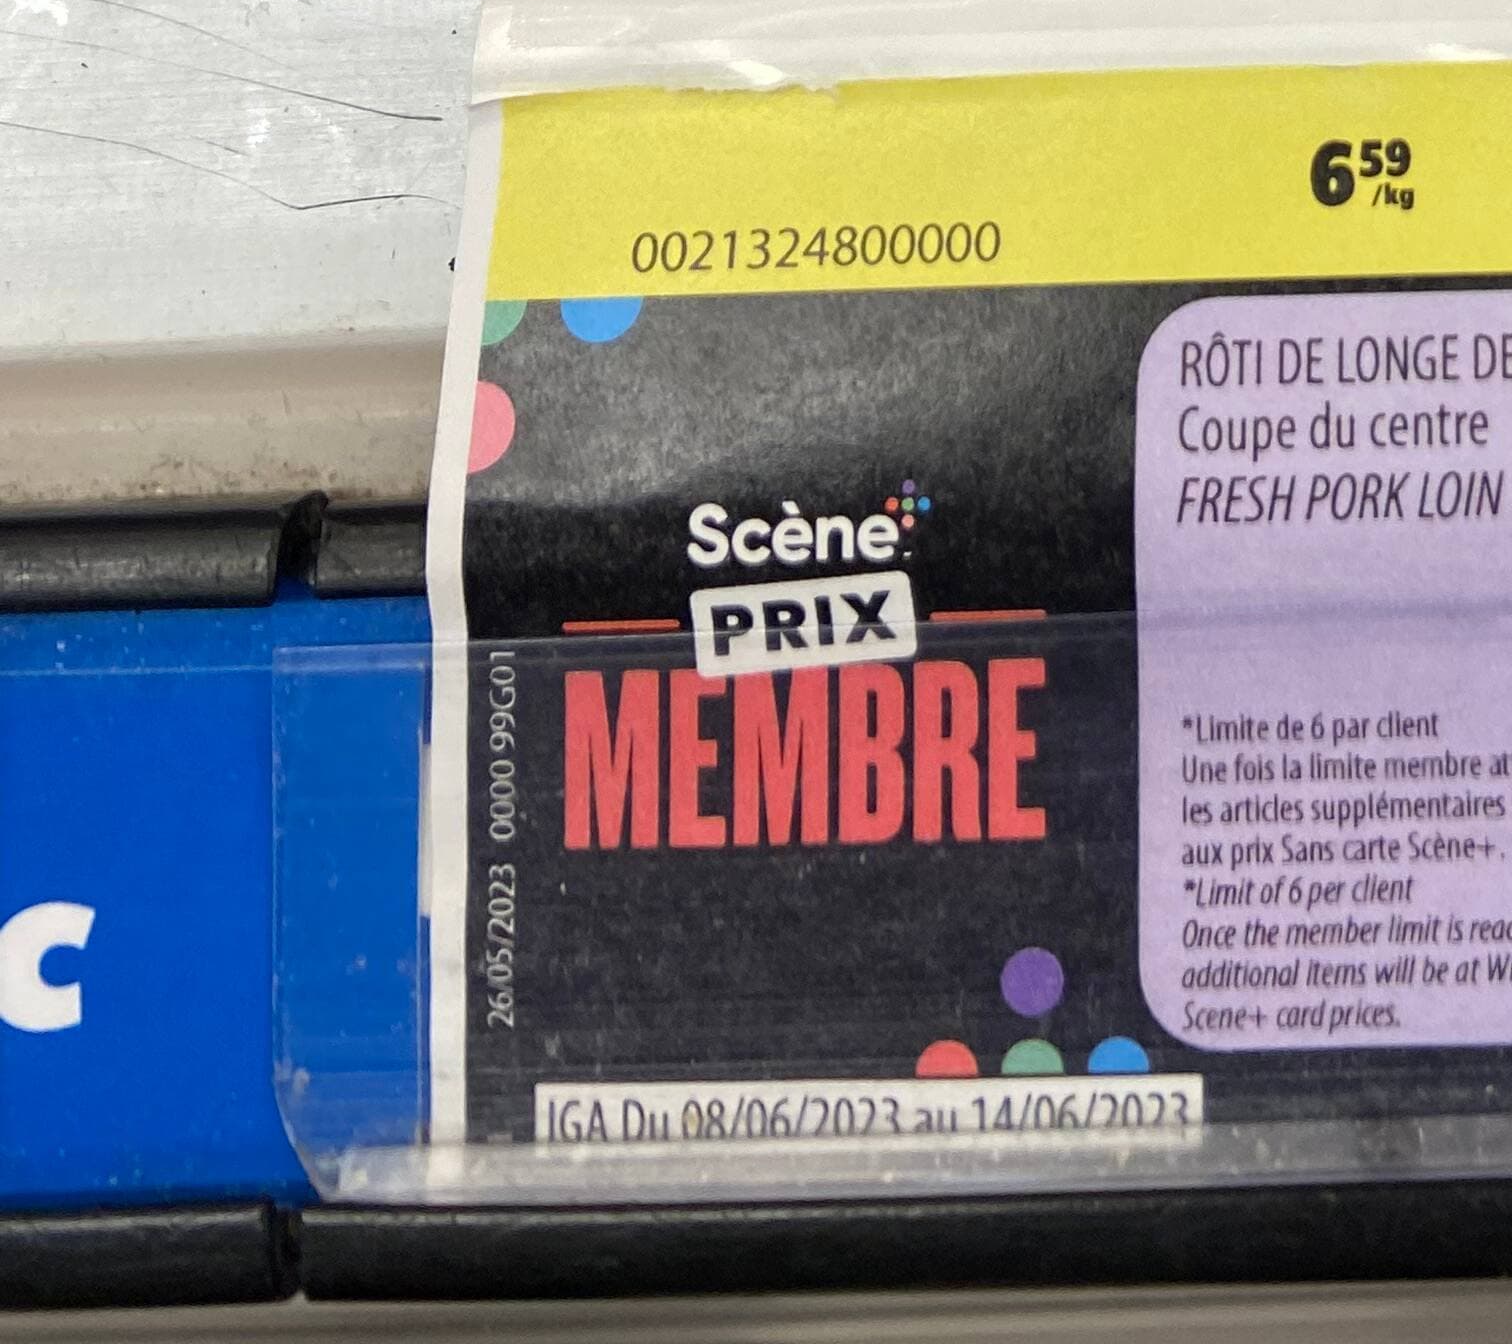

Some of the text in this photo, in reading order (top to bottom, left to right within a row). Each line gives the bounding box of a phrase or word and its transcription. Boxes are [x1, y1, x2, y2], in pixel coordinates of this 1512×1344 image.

[630, 220, 1001, 273] 0021324800000
[1180, 331, 1262, 388] RÔTI
[1278, 338, 1324, 386] DE
[1336, 334, 1460, 385] LONGE
[1178, 400, 1490, 462] Coupe du centre
[1176, 475, 1296, 525] FRESH
[1305, 471, 1412, 522] PORK
[1417, 468, 1504, 520] LOIN
[710, 589, 898, 657] PRIX
[1276, 714, 1304, 740] de
[1311, 714, 1325, 740] 6
[1333, 715, 1370, 746] par
[1377, 711, 1439, 739] client
[563, 658, 1047, 851] MEMBRE
[1182, 754, 1227, 783] Une
[1234, 753, 1275, 783] fois
[1282, 752, 1302, 781] la
[1309, 751, 1377, 780] limite
[1384, 750, 1482, 780] membre
[1182, 796, 1213, 825] les
[1220, 793, 1304, 824] articles
[1311, 790, 1506, 829] supplémentaires
[486, 650, 518, 1030] 26/05/2023 0000 99G01
[1182, 829, 1505, 870] aux prix Sans carte Scène+.
[1260, 877, 1281, 906] of
[1288, 877, 1303, 904] 6
[1307, 878, 1346, 911] per
[1352, 875, 1414, 903] client
[1182, 919, 1236, 949] Once
[1244, 919, 1279, 948] the
[1285, 917, 1380, 947] member
[1387, 914, 1441, 944] limit
[1447, 914, 1464, 943] is
[1181, 960, 1299, 990] additional
[1306, 959, 1366, 987] items
[1375, 956, 1415, 985] will
[1422, 956, 1447, 984] be
[1455, 957, 1480, 983] at
[1182, 998, 1400, 1034] Scene+ card prices.
[546, 1090, 1190, 1144] IGA Du 08/06/2023 au 14/06/2023
